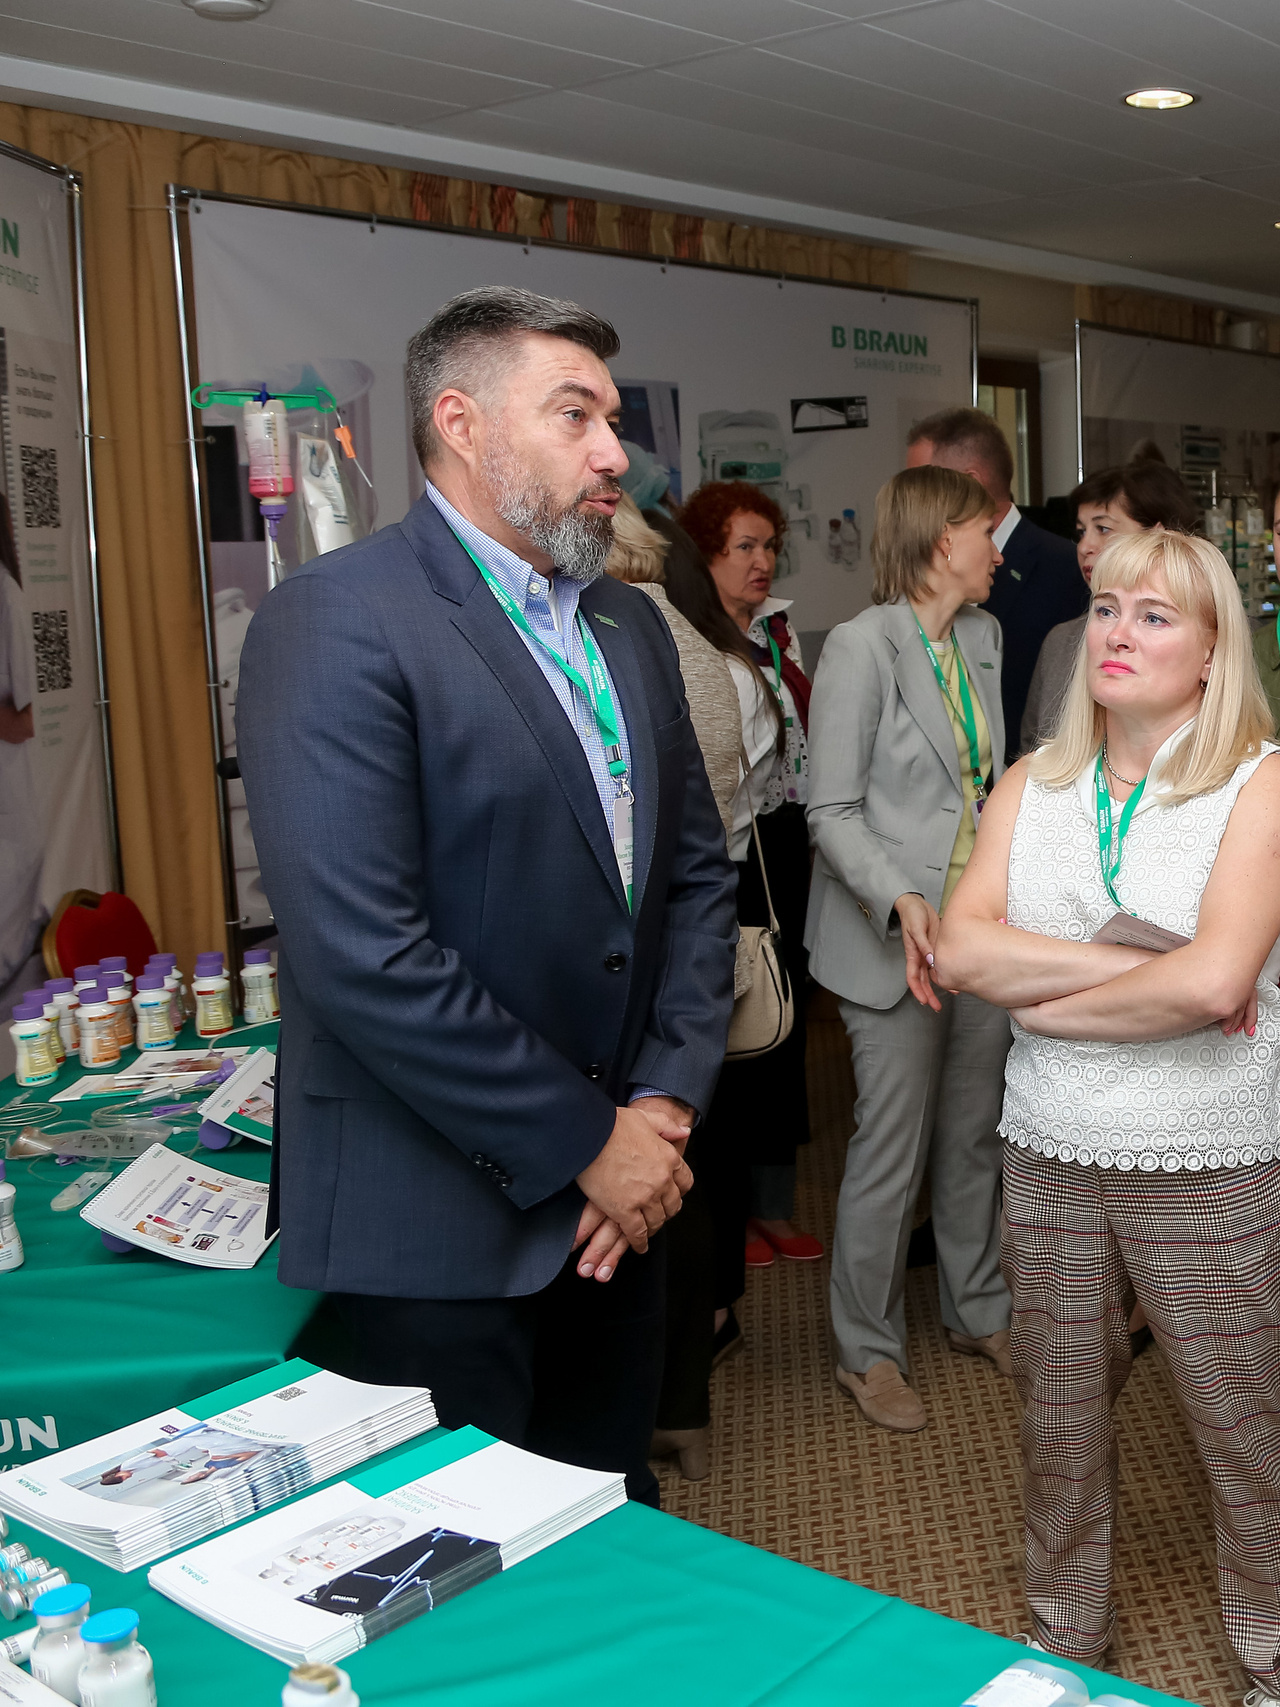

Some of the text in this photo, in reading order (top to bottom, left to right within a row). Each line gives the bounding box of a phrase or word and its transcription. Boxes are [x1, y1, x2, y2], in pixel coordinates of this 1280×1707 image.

[831, 325, 928, 357] B BRAUN
[595, 665, 607, 690] BRAUN
[330, 1594, 360, 1604] Normal
